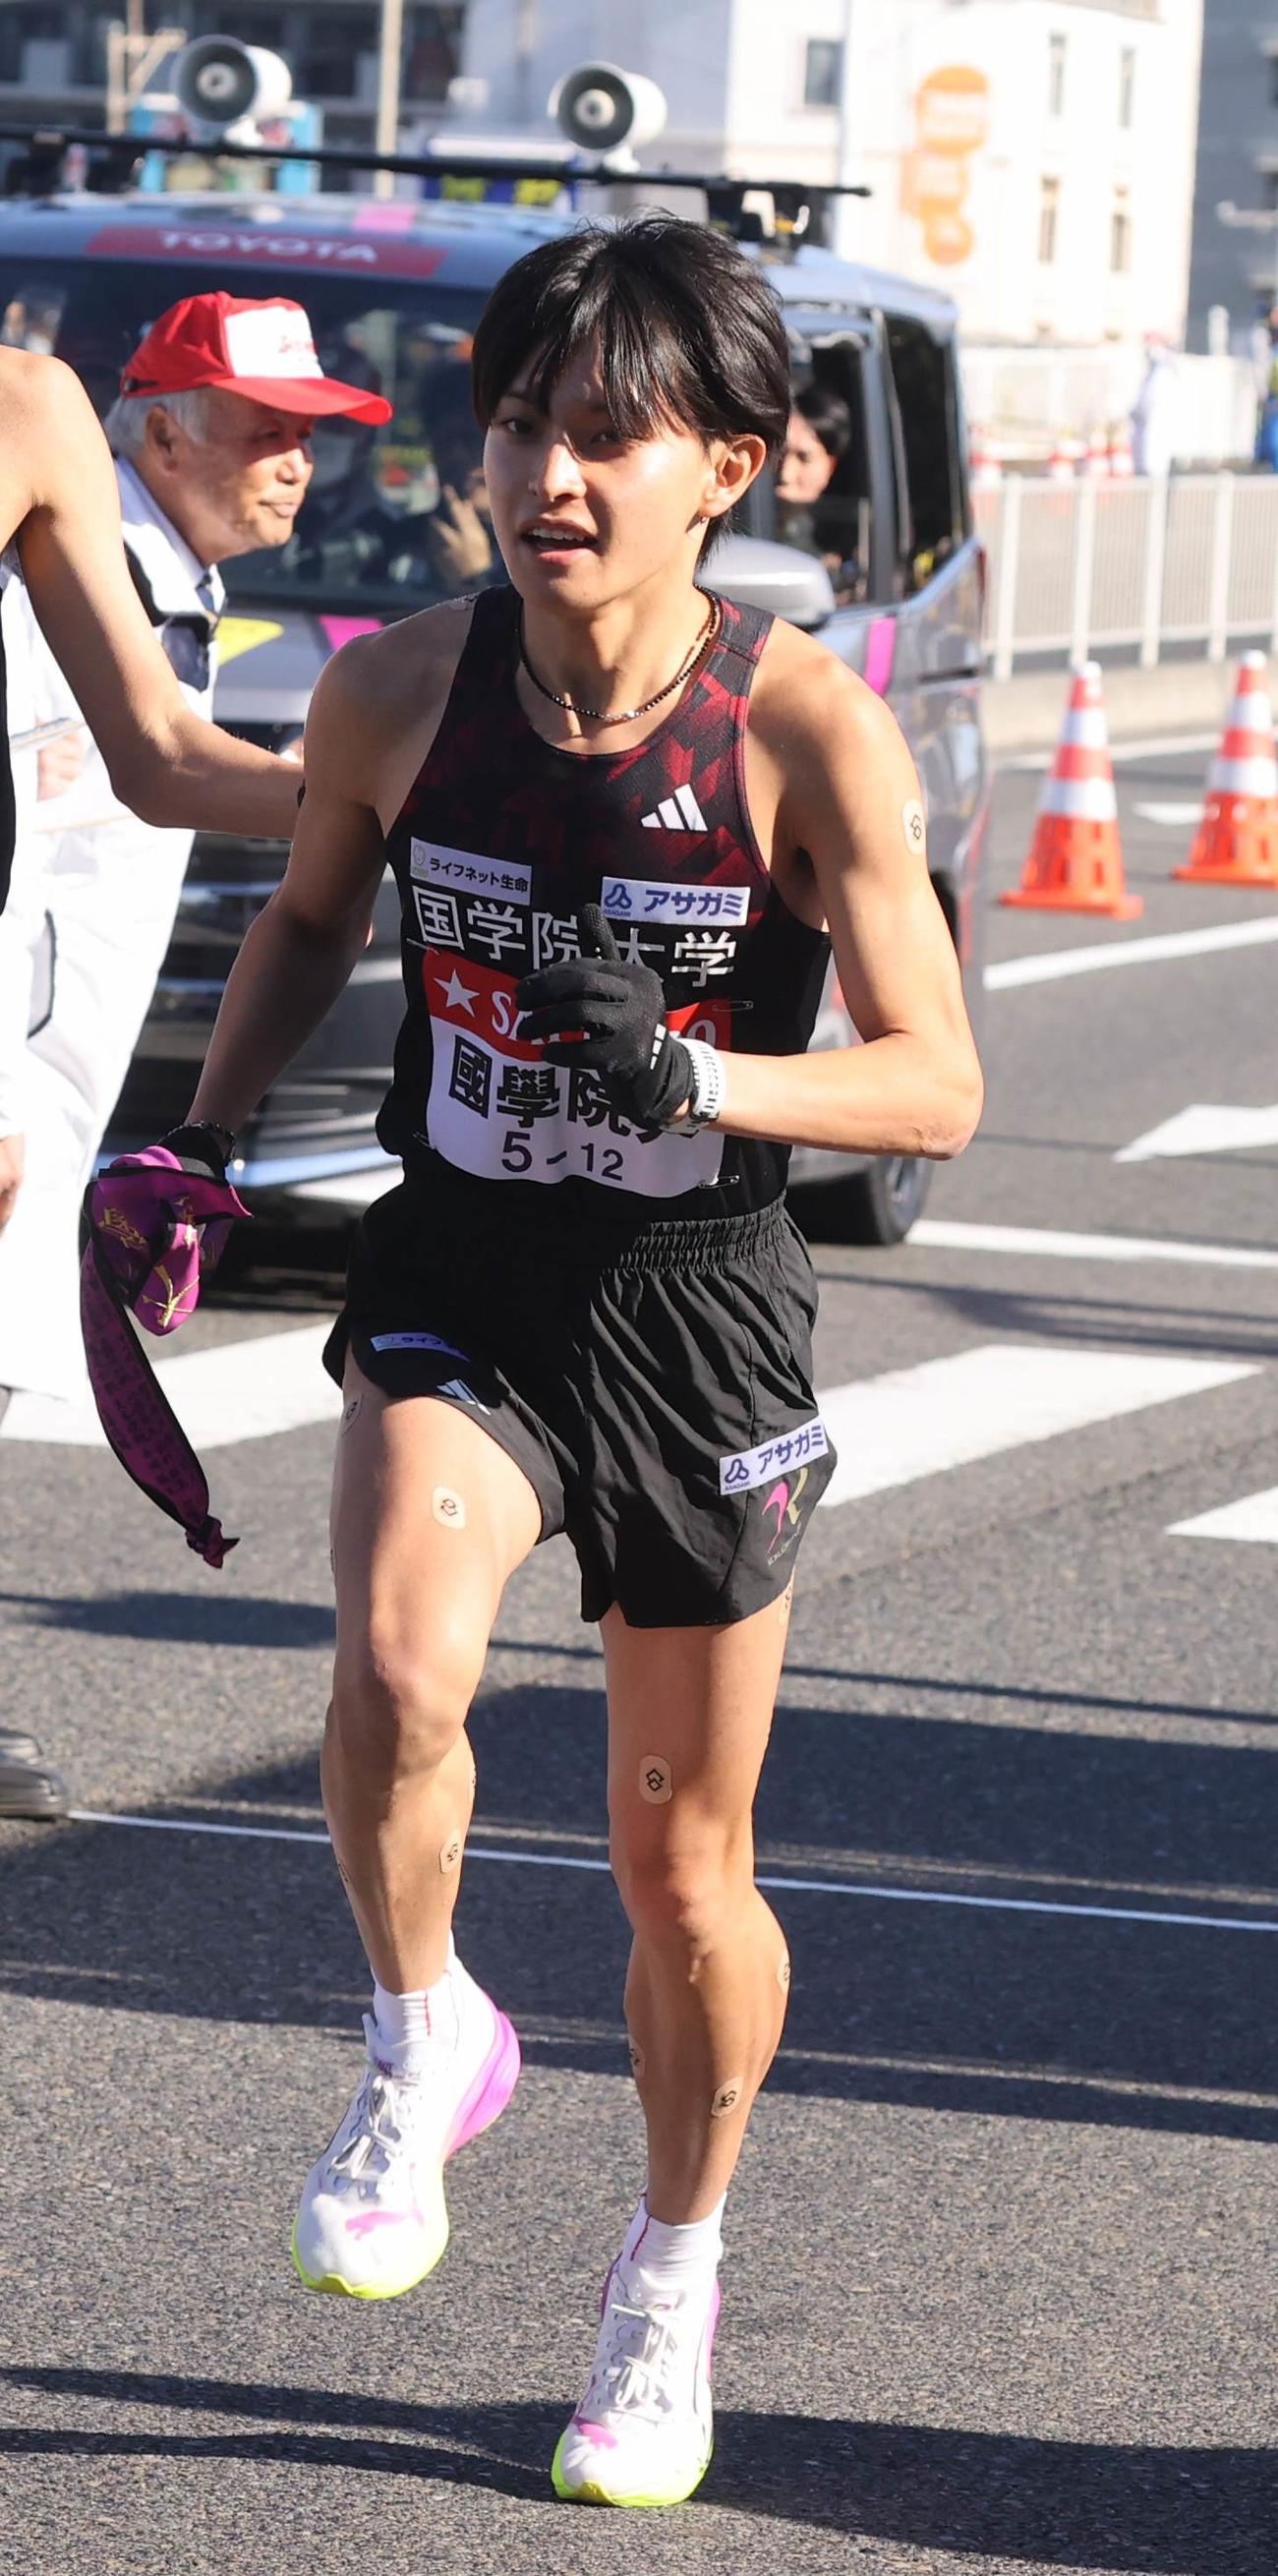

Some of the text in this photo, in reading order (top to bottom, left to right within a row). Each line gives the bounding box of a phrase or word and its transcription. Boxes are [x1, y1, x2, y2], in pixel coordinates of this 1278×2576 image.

[158, 230, 378, 263] TOYOTA
[430, 857, 529, 893] ライフネット生命
[644, 889, 743, 916] アサガミ
[448, 1034, 700, 1144] 國學院
[758, 1425, 824, 1475] アサガミ
